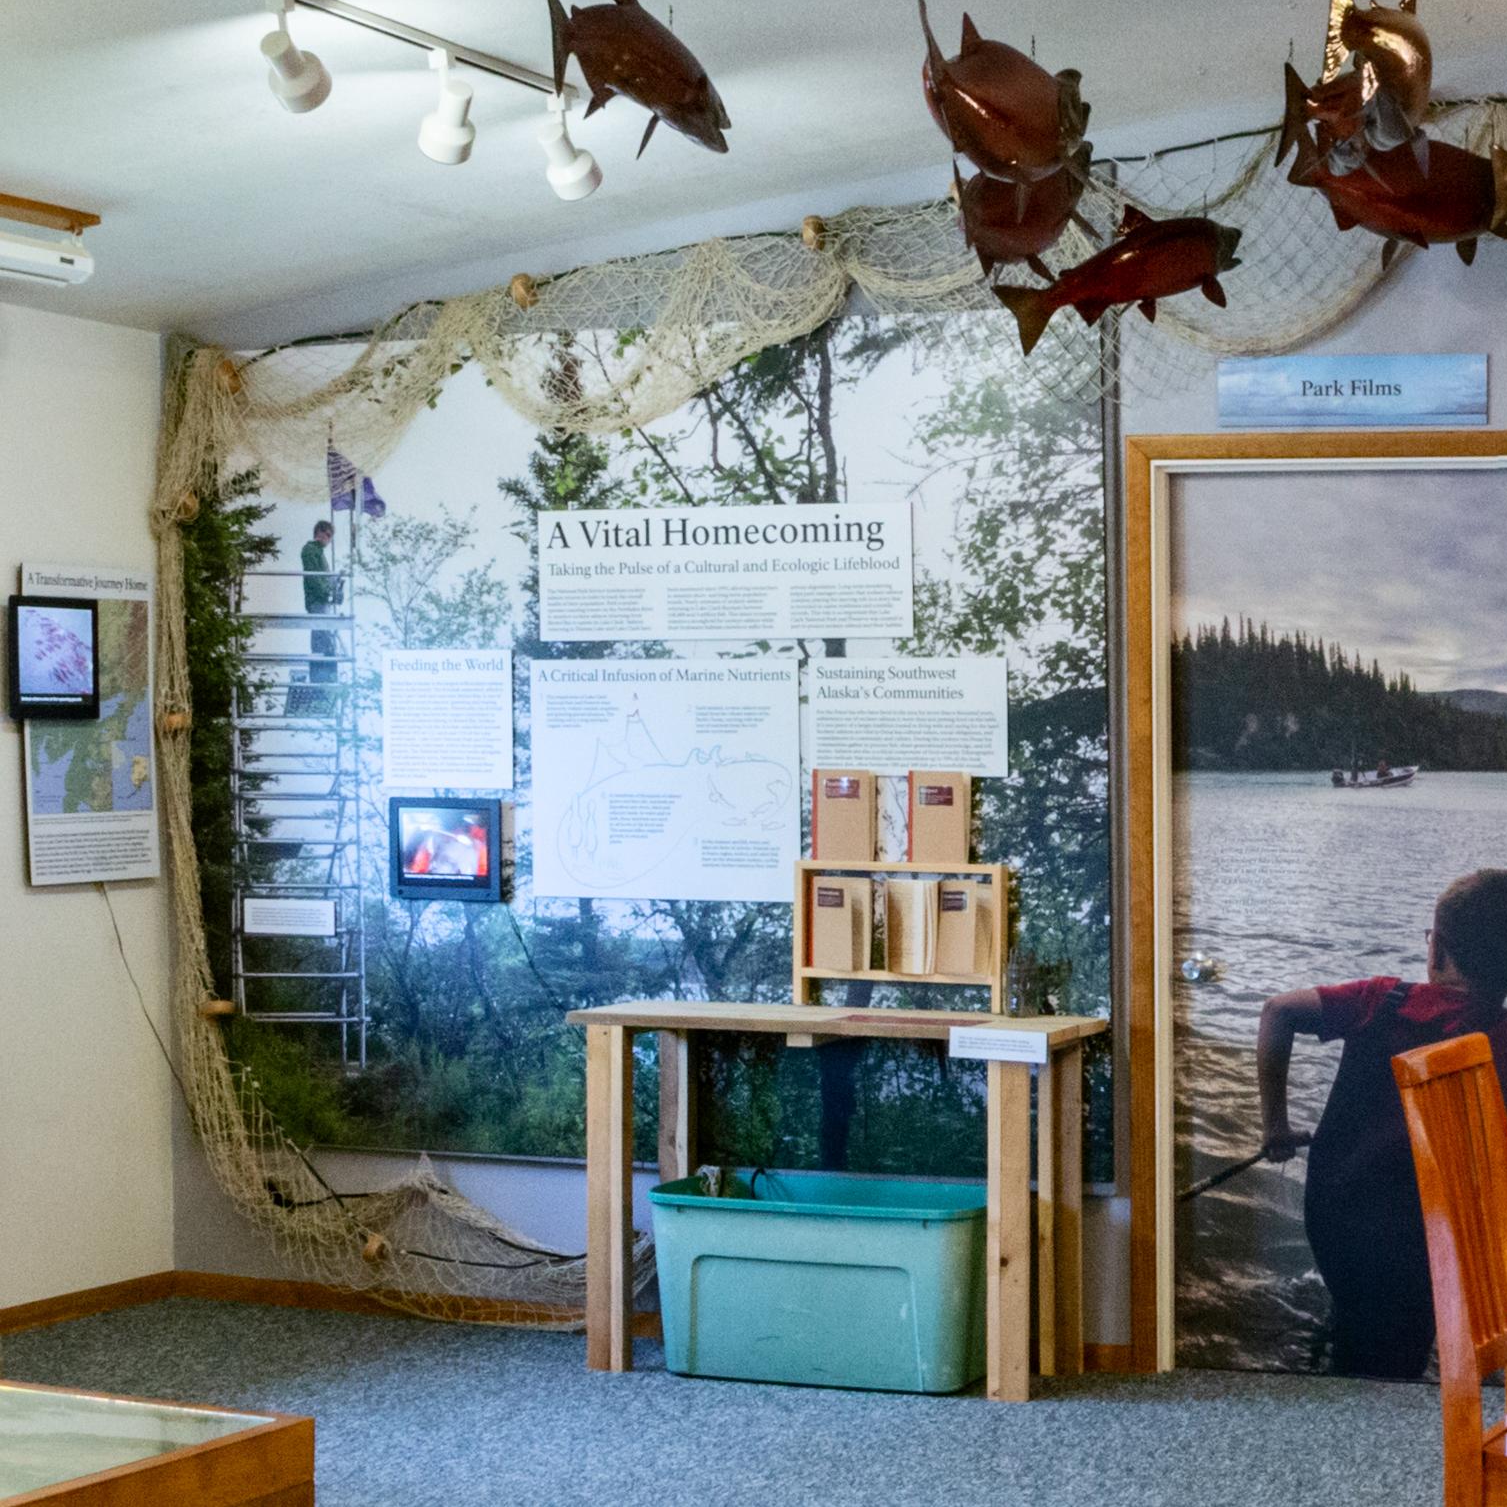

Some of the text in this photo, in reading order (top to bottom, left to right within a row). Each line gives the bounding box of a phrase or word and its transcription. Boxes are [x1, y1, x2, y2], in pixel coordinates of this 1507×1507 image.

[1302, 379, 1402, 397] Park Films
[547, 513, 885, 551] A Vital Homecoming
[548, 556, 901, 580] Taking the Pulse of a Cultural and Ecologic Lifeblood
[29, 573, 147, 592] A Transformative Journey Home
[390, 658, 503, 674] Feeding the World
[816, 666, 956, 683] Sustaining Southwest
[538, 668, 792, 682] A Critical Infusion of Marine Nutrients
[816, 686, 964, 699] Alaska's Communities
